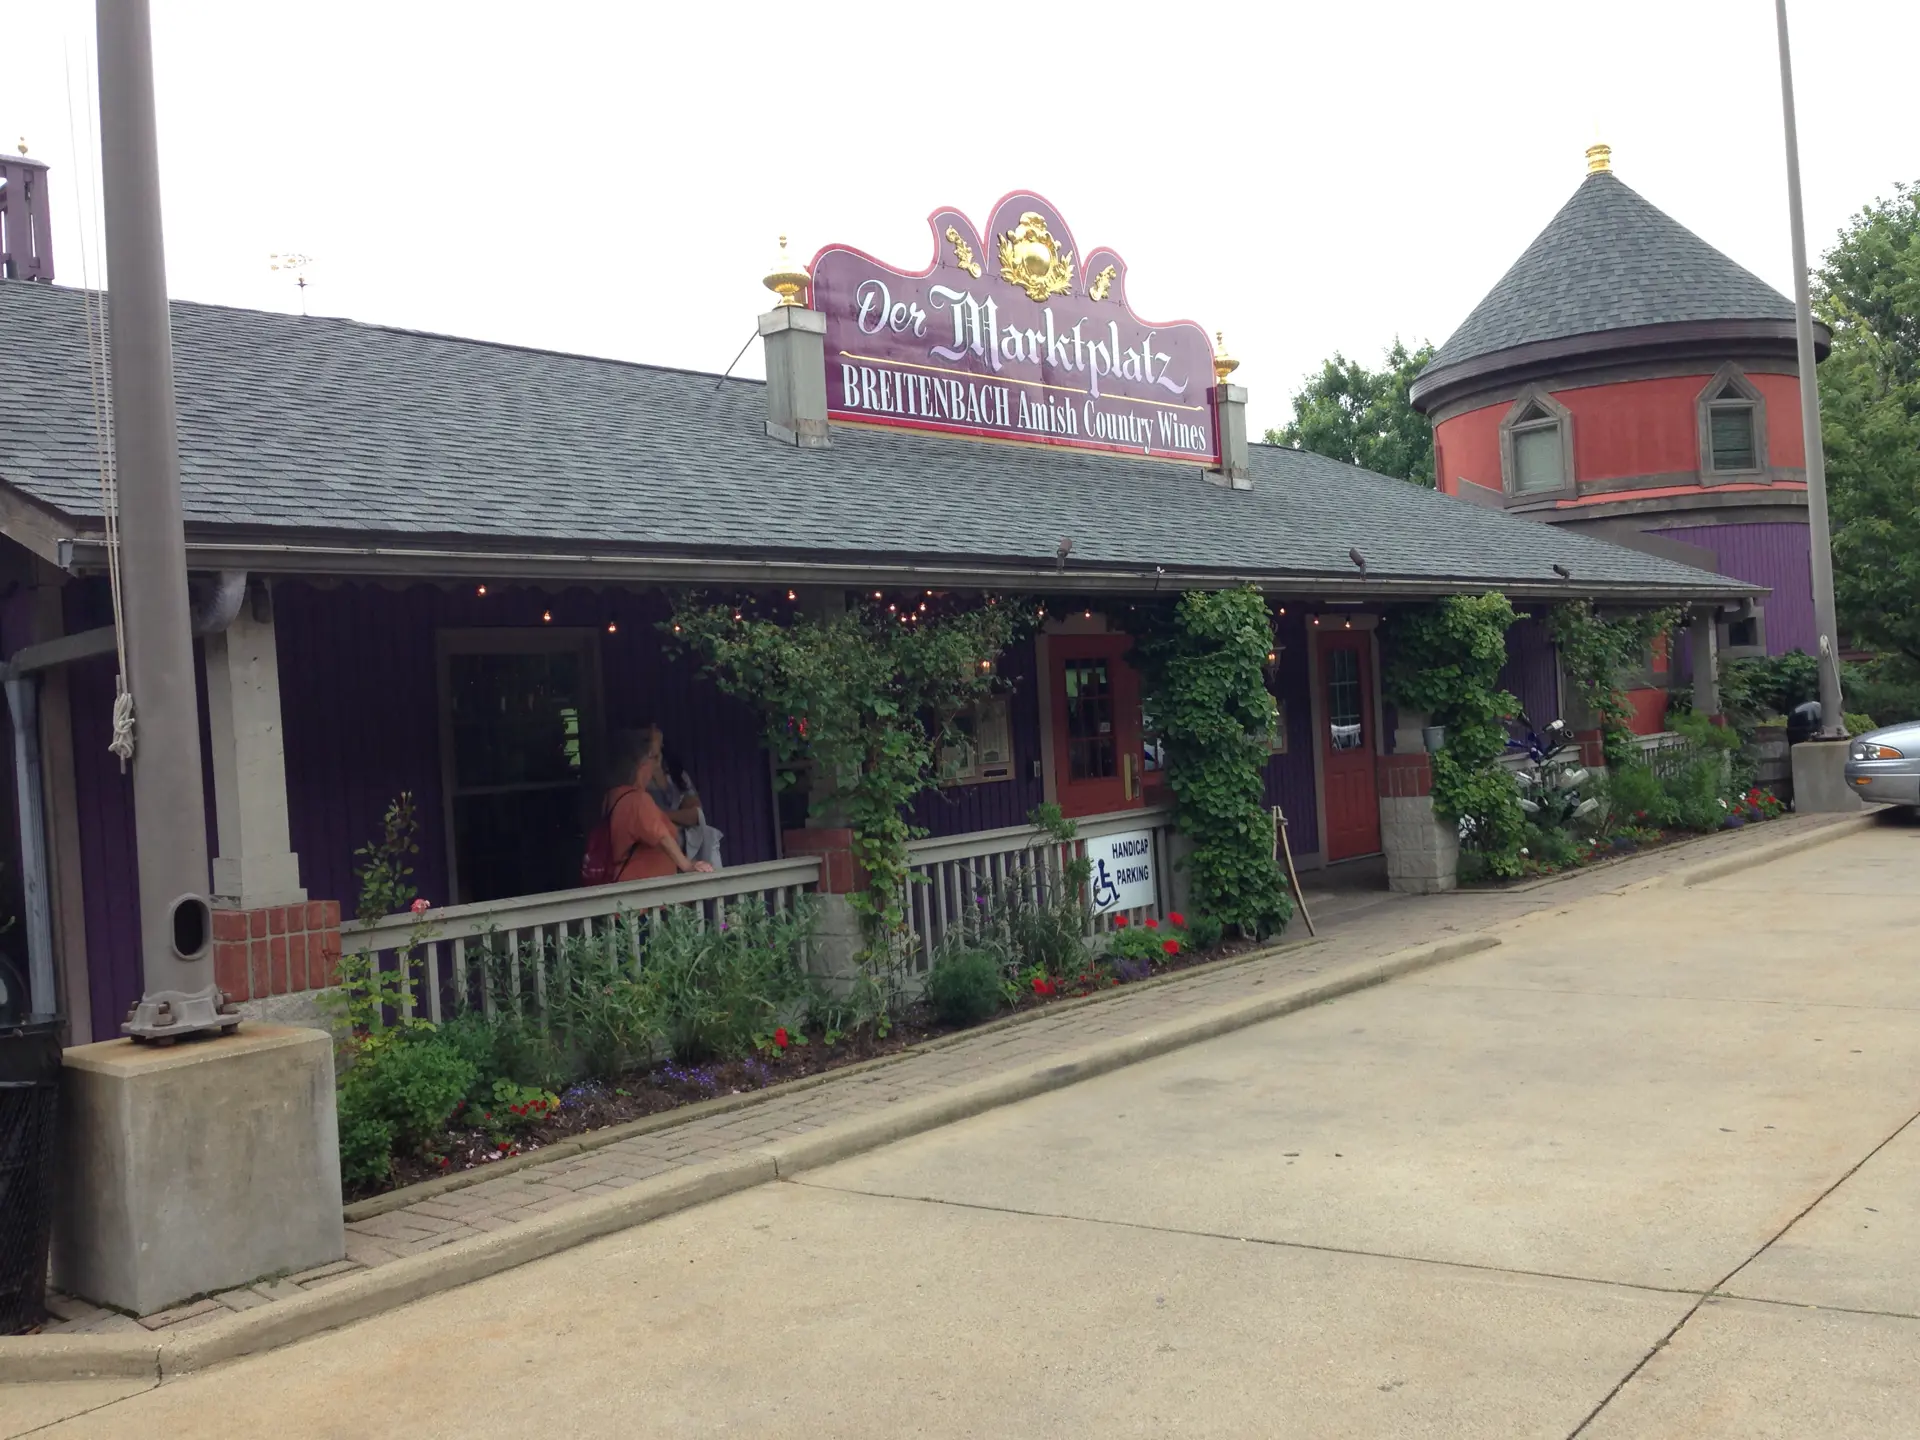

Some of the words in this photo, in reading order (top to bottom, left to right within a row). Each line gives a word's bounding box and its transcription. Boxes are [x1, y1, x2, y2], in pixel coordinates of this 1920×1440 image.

[857, 279, 928, 338] Der
[930, 284, 1189, 397] Marktplatz
[842, 364, 1010, 427] BREITENBACH
[1016, 389, 1079, 435] Amish
[1083, 401, 1154, 455] Country
[1156, 411, 1206, 452] Wines
[1112, 838, 1149, 860] HANDICAP
[1116, 865, 1149, 886] PARKING
